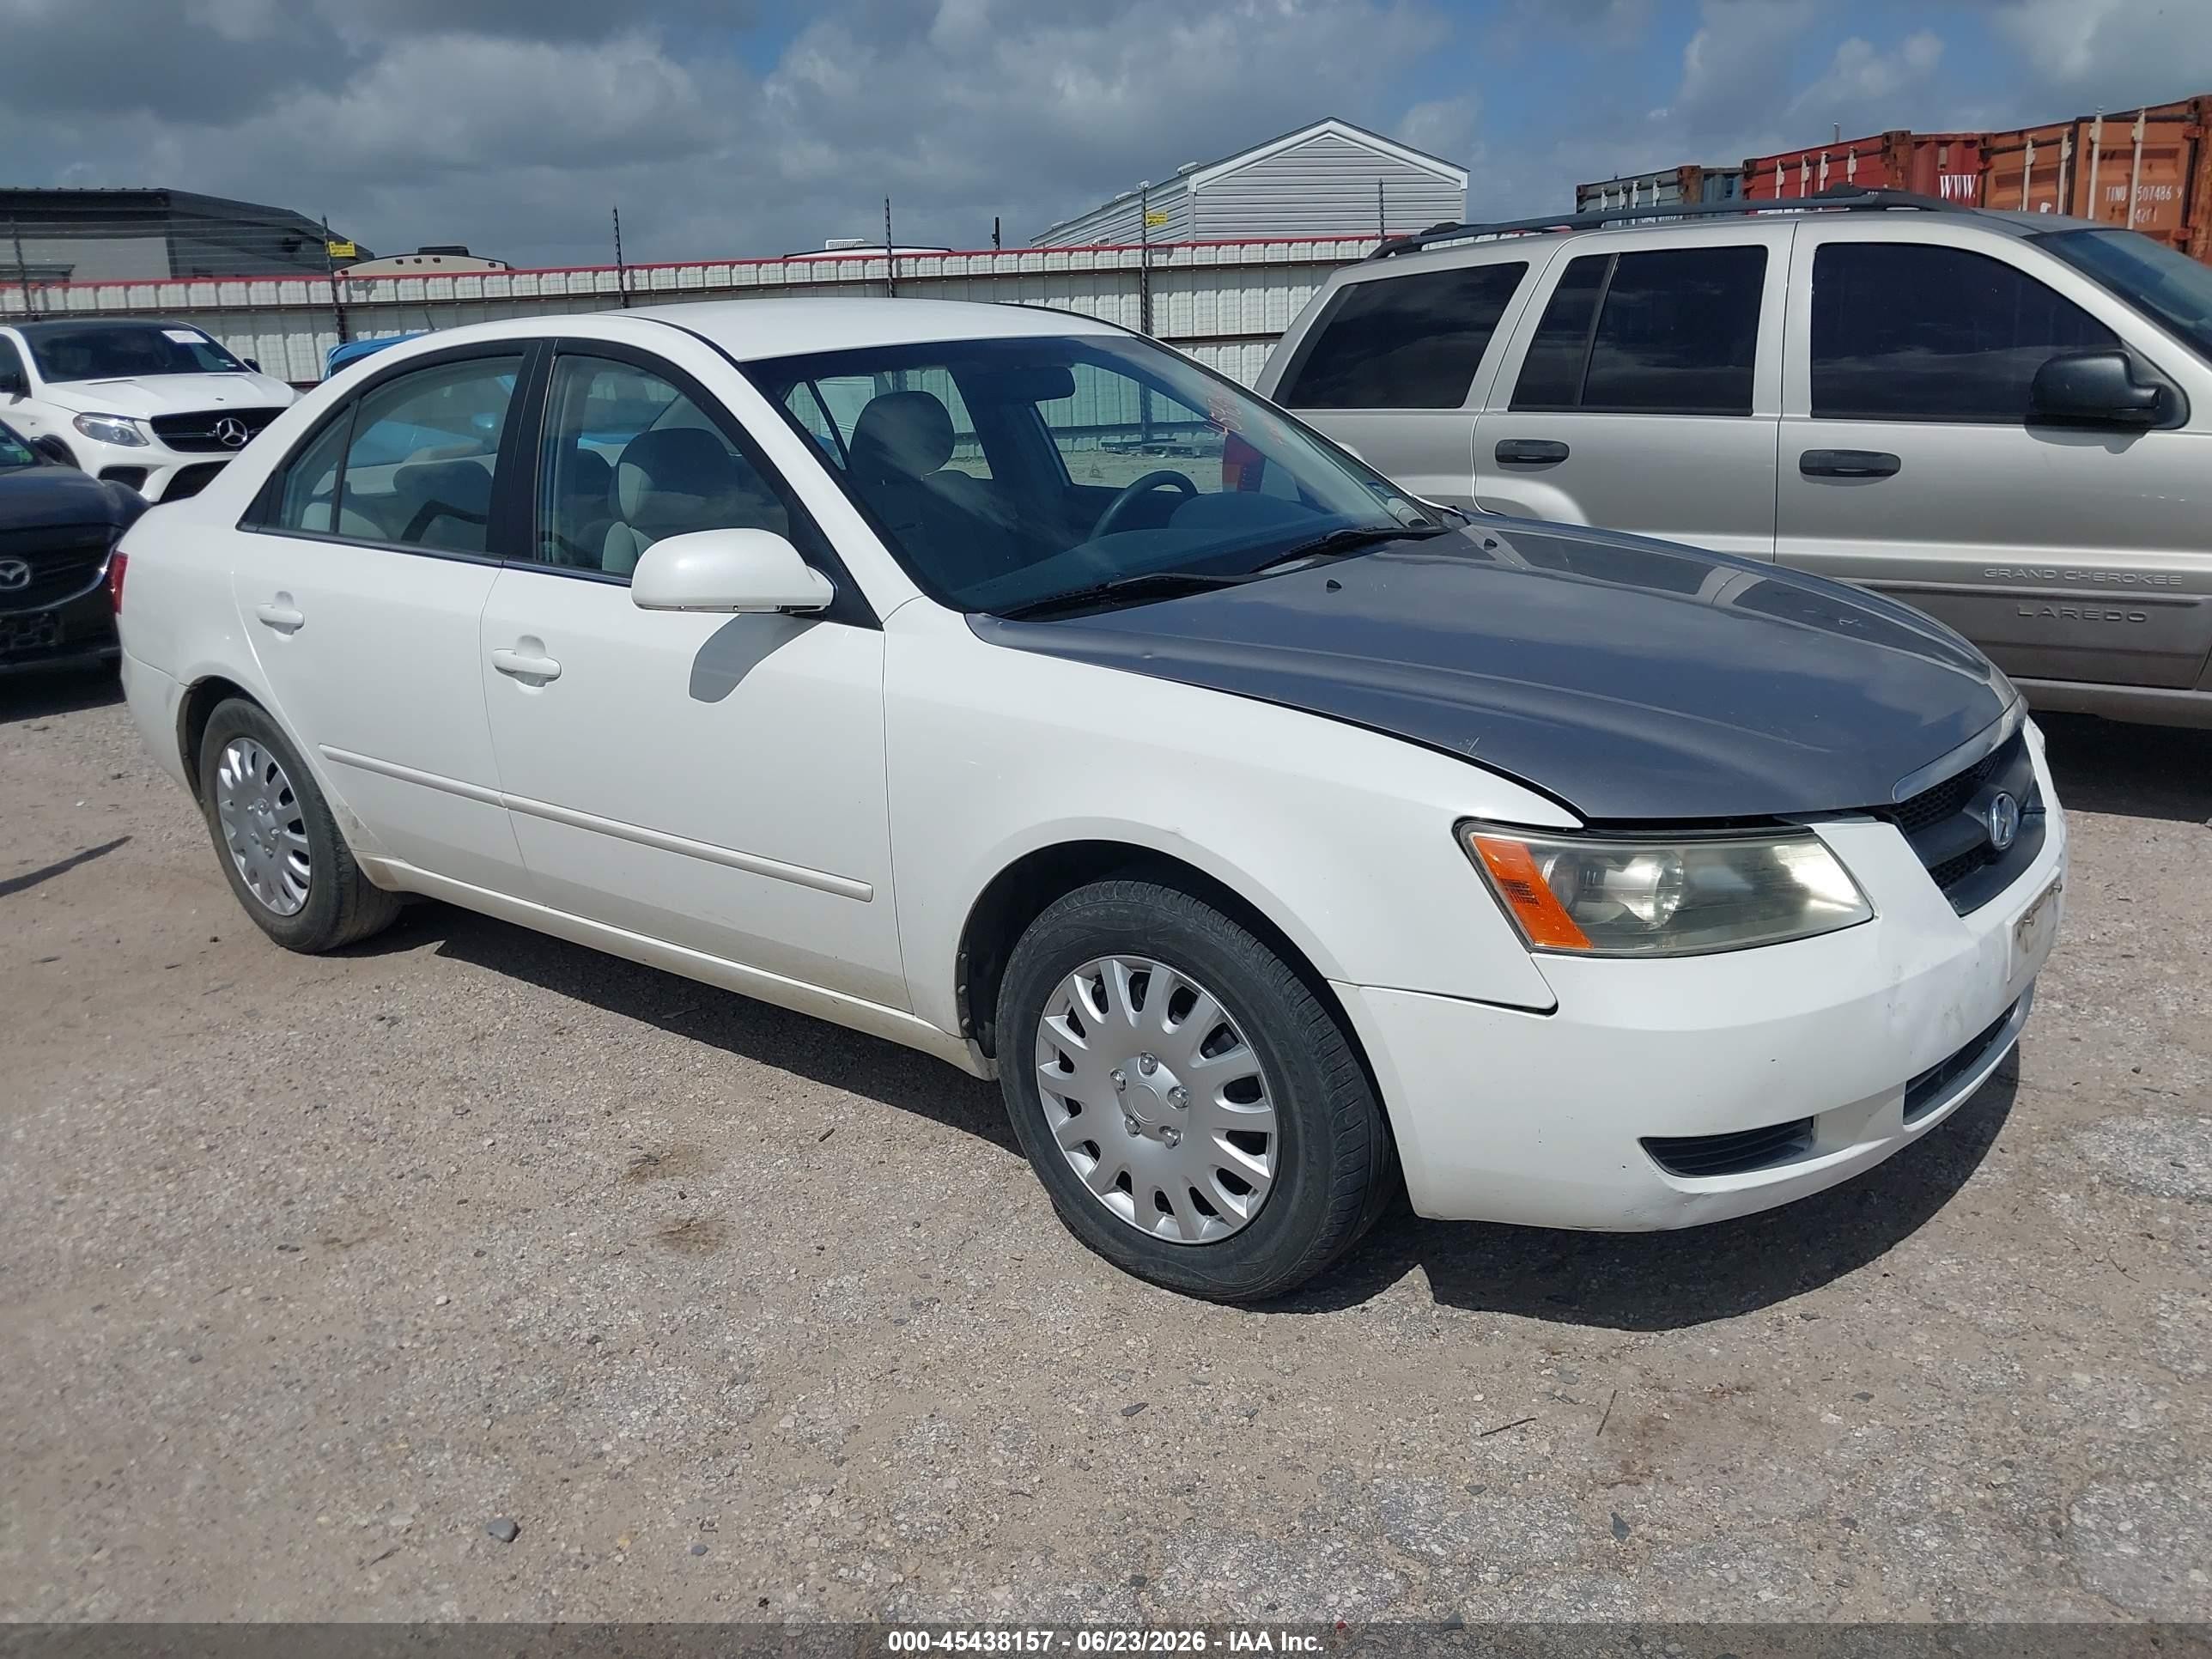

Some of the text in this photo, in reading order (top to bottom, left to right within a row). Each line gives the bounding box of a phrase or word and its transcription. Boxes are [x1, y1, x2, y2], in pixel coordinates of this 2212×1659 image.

[1984, 568, 2184, 586] GRAND CHEROKEE
[2016, 605, 2148, 623] LAREDO
